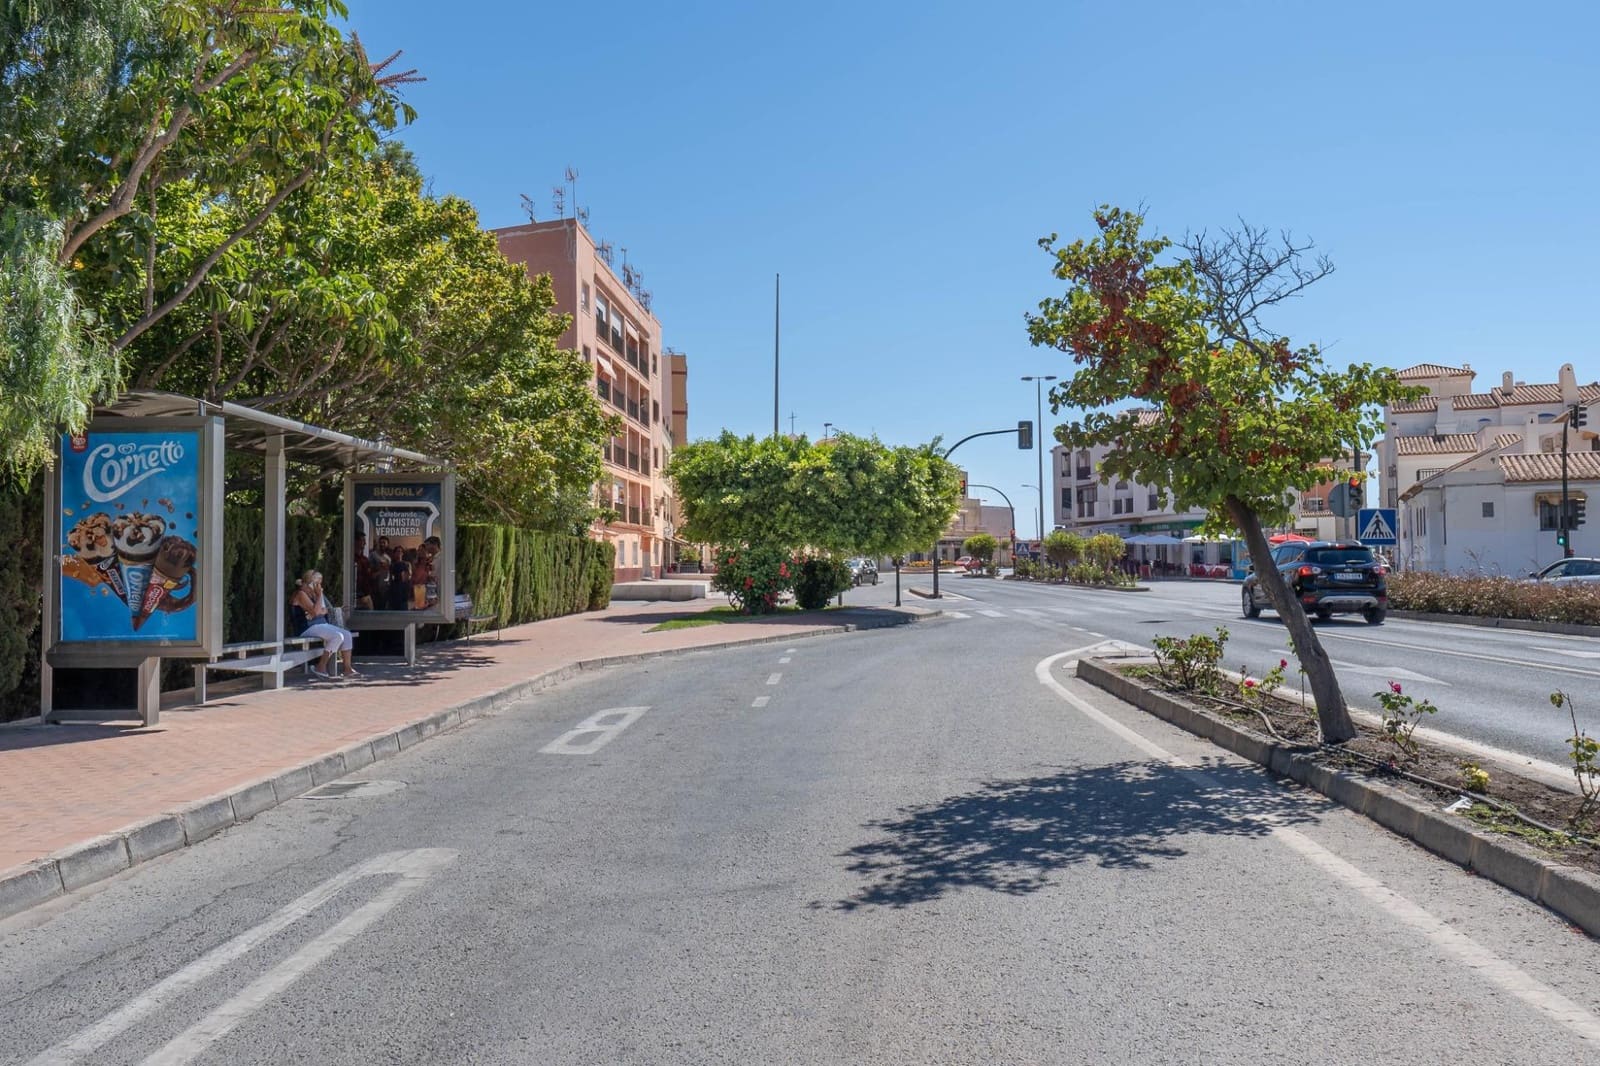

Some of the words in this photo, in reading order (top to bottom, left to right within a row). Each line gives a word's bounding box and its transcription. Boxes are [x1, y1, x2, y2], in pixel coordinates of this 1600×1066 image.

[83, 441, 184, 502] Cornetto
[374, 487, 415, 496] BRUGAL
[375, 518, 386, 527] LA
[387, 518, 421, 527] AMISTAD
[376, 527, 421, 536] VERDADERA
